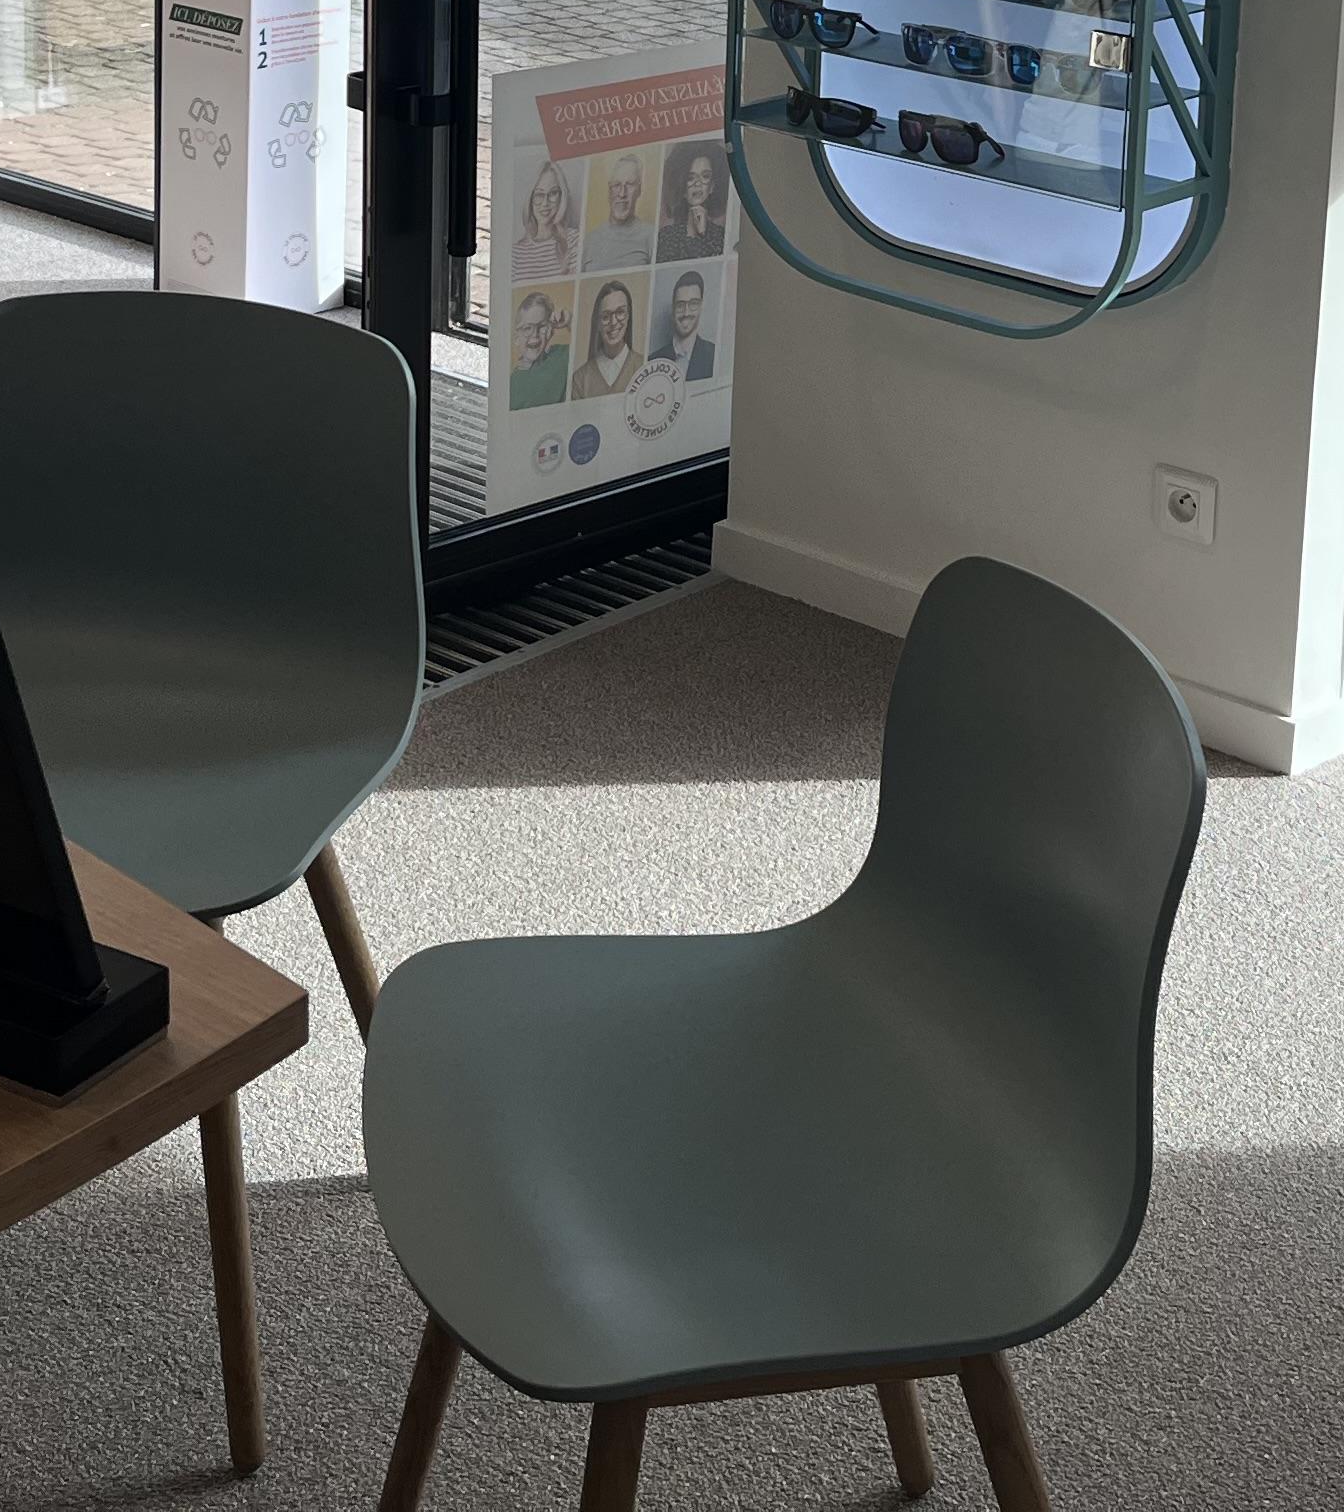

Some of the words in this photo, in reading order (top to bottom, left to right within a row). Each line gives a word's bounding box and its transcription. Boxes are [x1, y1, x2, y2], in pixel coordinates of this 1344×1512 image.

[193, 11, 241, 33] DÉPOSEZ
[259, 28, 267, 46] 1
[257, 51, 268, 70] 2
